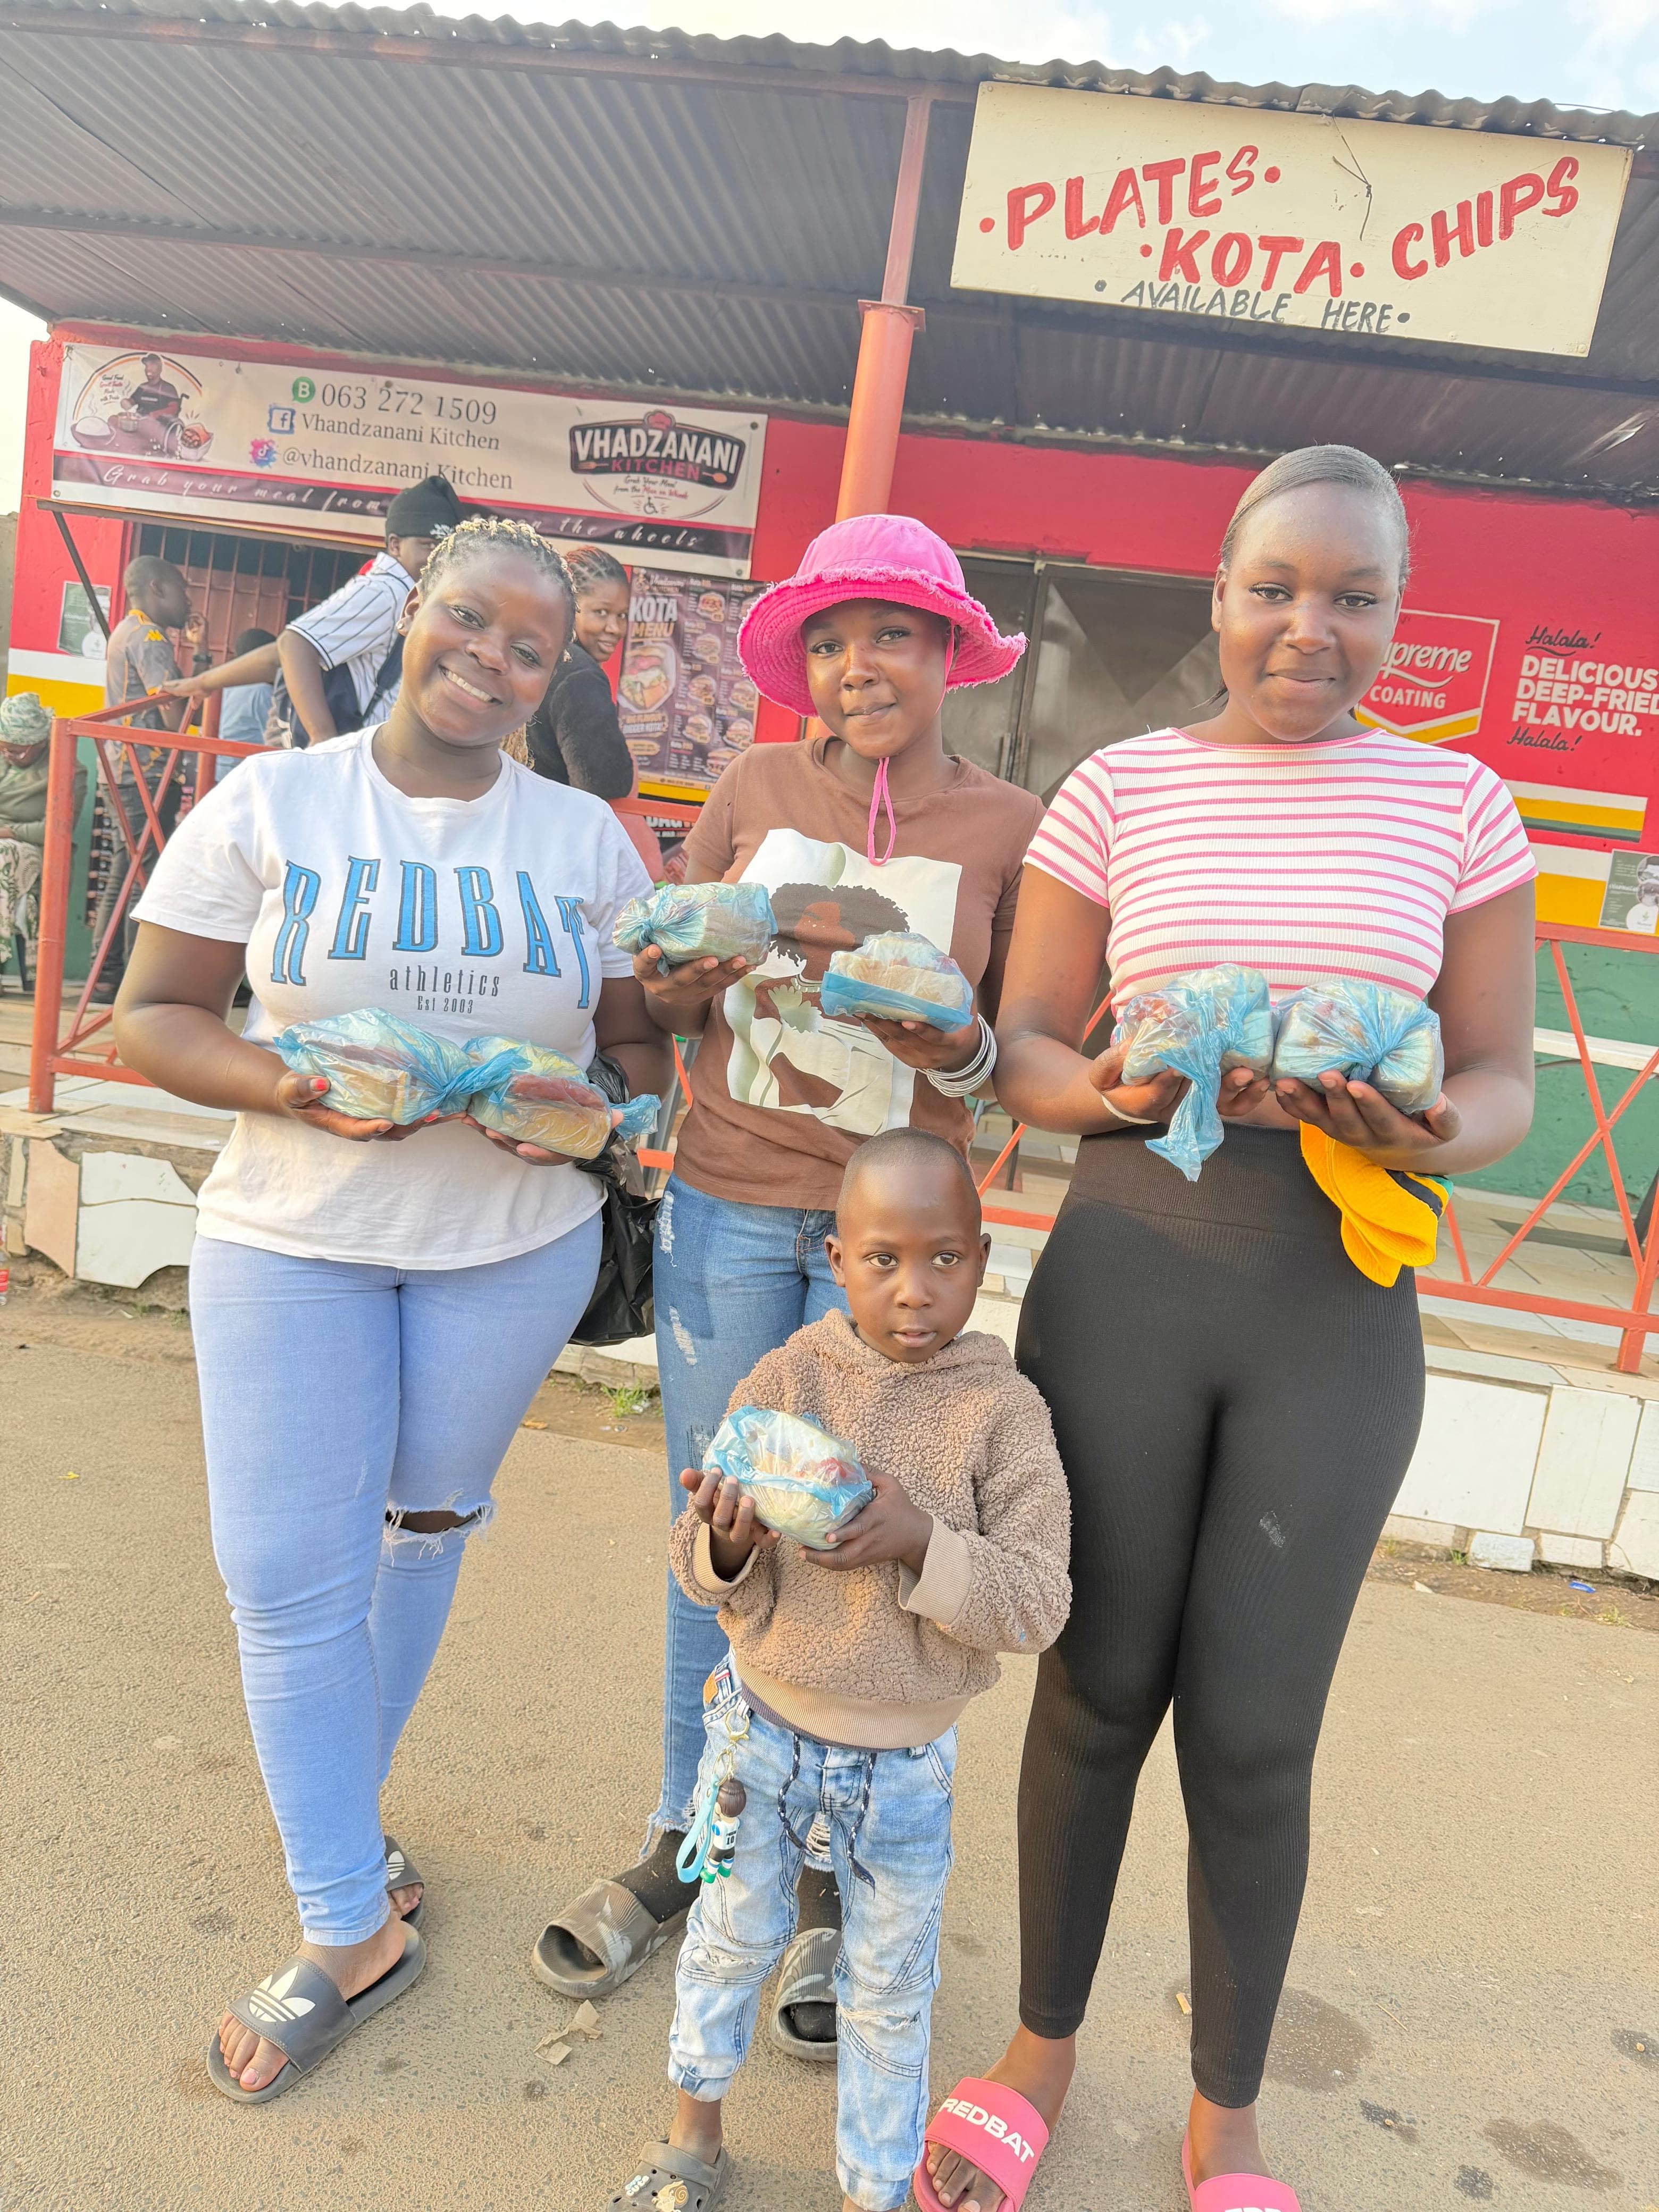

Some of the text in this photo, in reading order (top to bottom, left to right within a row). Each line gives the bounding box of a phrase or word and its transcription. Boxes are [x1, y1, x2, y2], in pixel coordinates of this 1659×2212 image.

[1007, 145, 1259, 250] PLATES
[1159, 156, 1579, 298] KOTA CHIPS
[1120, 280, 1394, 333] AVAILABLE HERE
[322, 383, 366, 409] 063
[378, 388, 423, 415] 272
[434, 396, 496, 425] 1509
[301, 413, 423, 442] Vhandzanani
[430, 428, 500, 450] Kitchen
[283, 447, 512, 489] @vhandzanani Kitchen
[574, 428, 740, 474] VHADZANANI
[611, 459, 700, 481] KITCHEN
[103, 464, 167, 485] Grab
[182, 477, 238, 496] your
[254, 487, 312, 503] meal
[322, 491, 381, 512] from
[559, 517, 598, 536] the
[614, 525, 698, 547] wheels
[628, 595, 678, 622] KOTA
[632, 622, 674, 638] MENU
[1525, 625, 1602, 649] Halala!
[1521, 655, 1659, 691] DELICIOUS
[1370, 685, 1446, 709] COATING
[1512, 700, 1642, 736] FLAVOUR.
[1506, 726, 1582, 751] Halala!
[270, 855, 590, 1009] REDBAT
[390, 965, 500, 998] athletics
[417, 995, 473, 1014] Est 2003
[937, 2098, 1035, 2164] REDBAT
